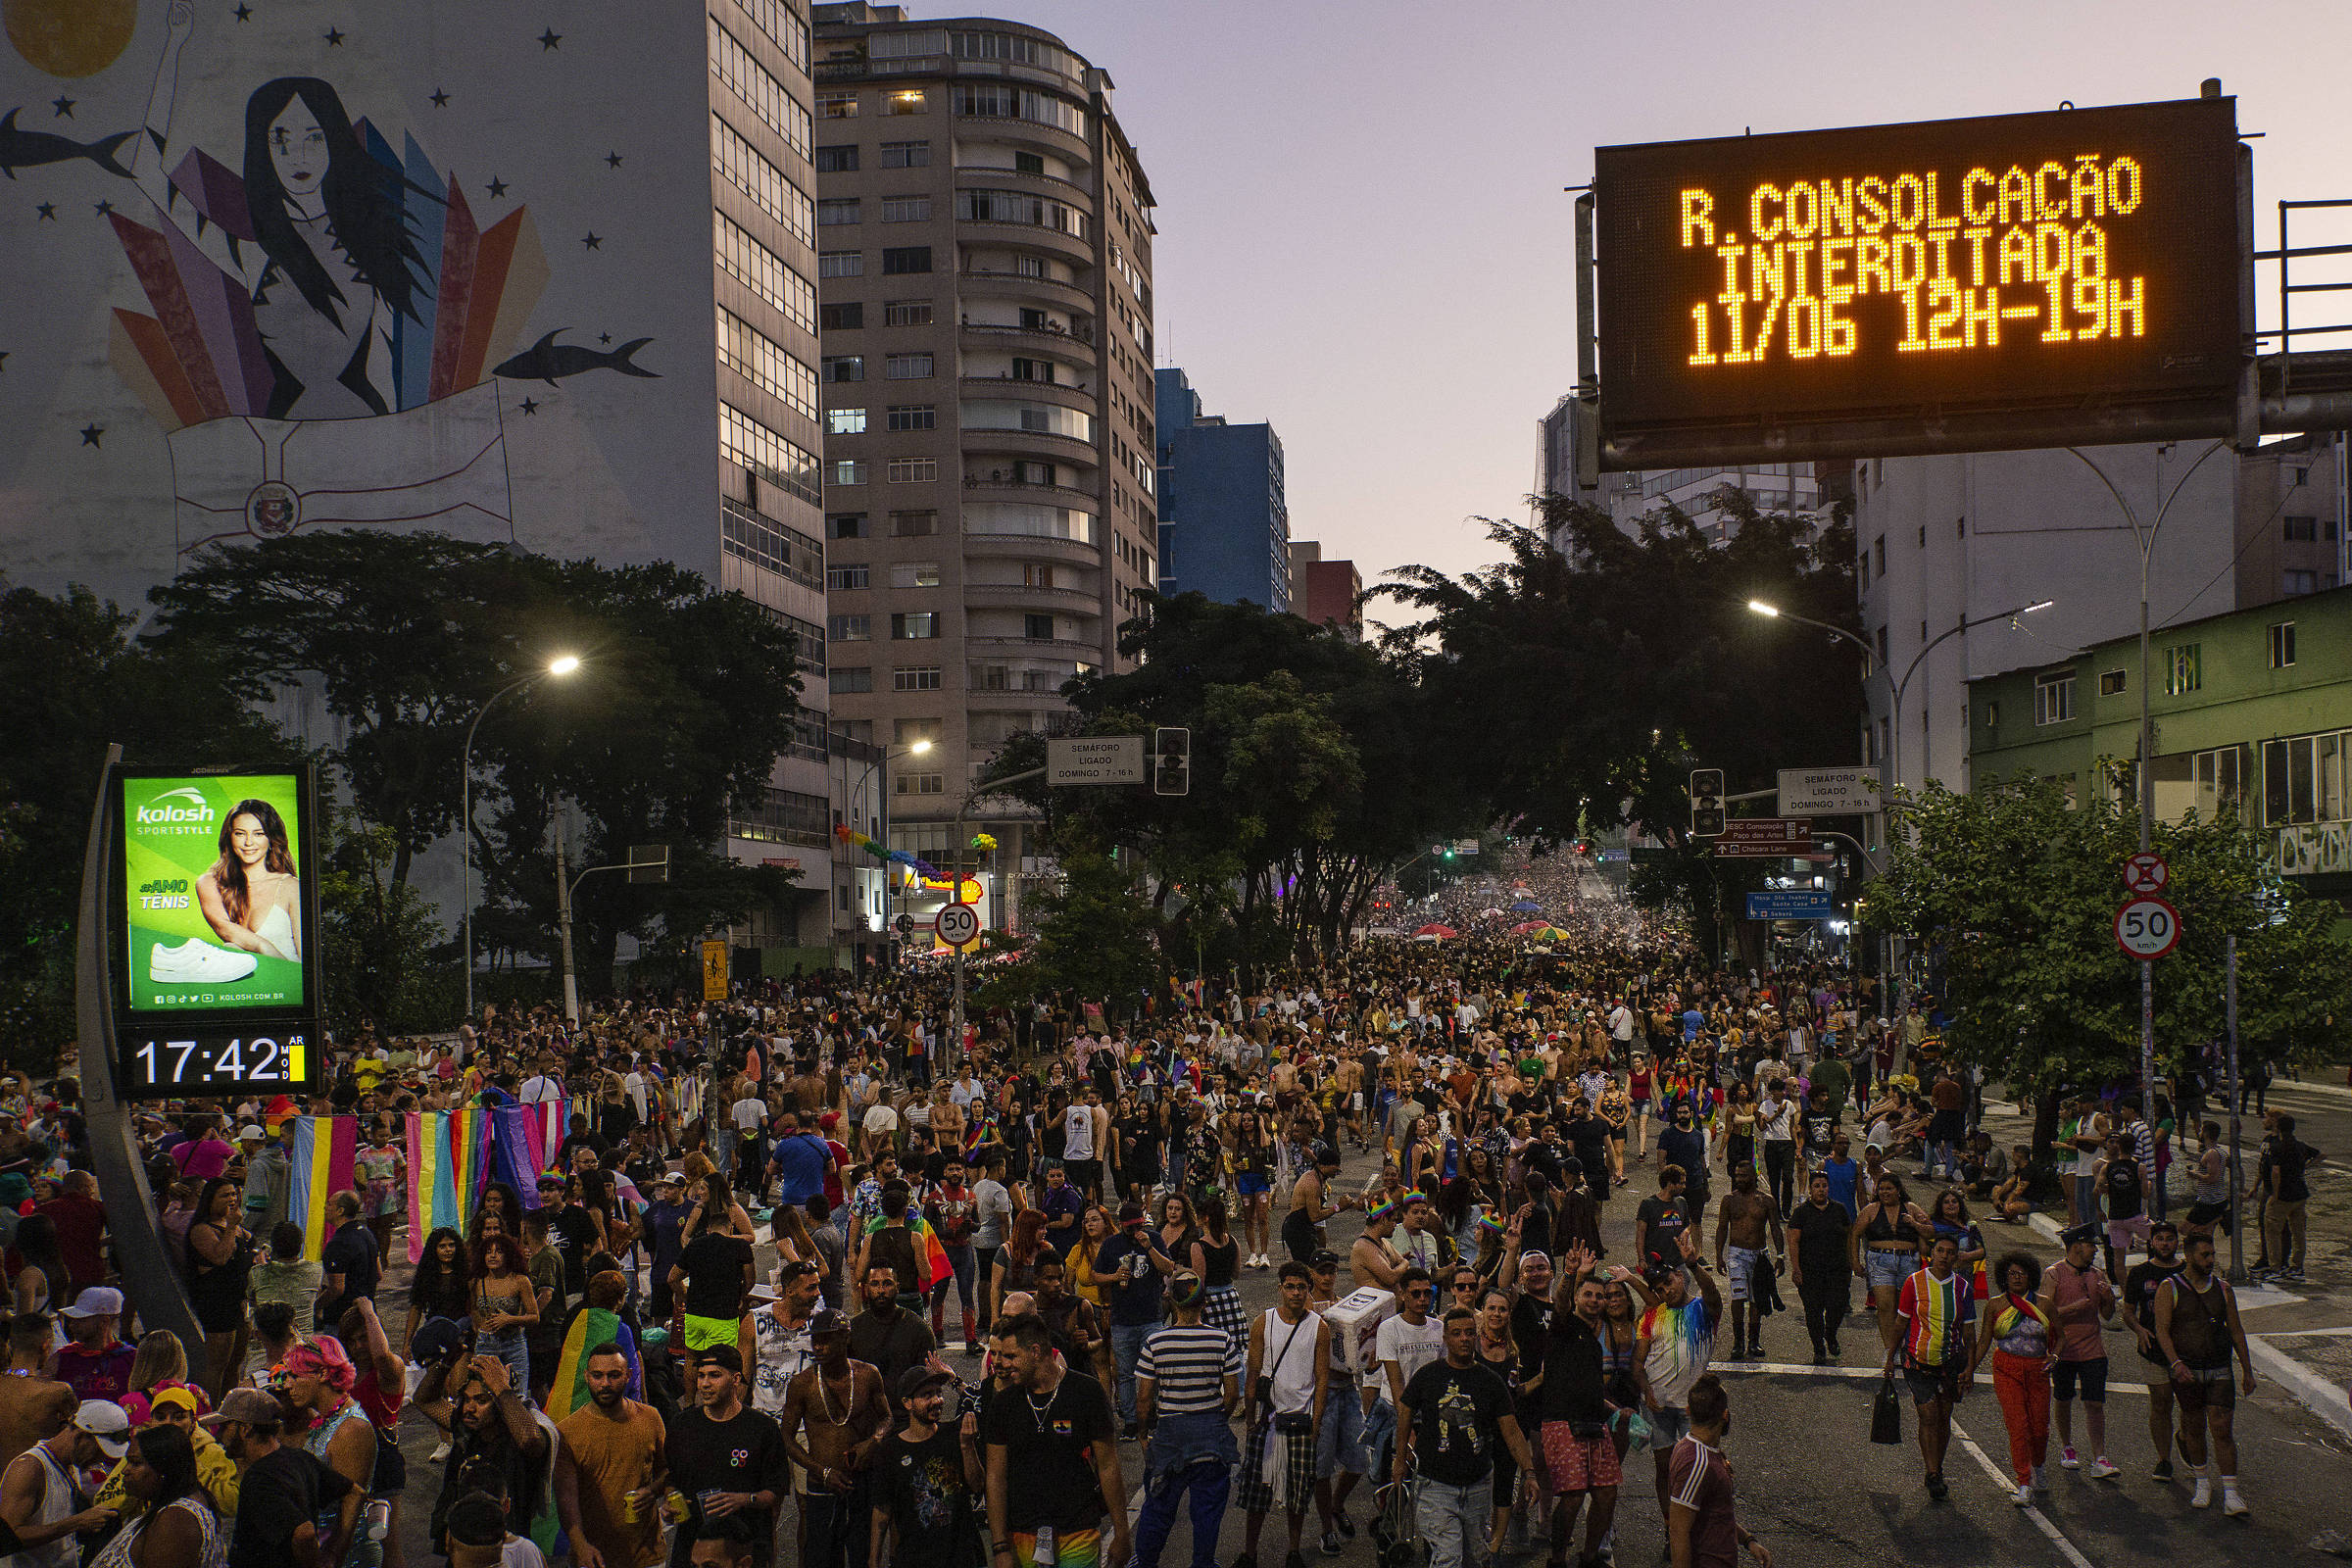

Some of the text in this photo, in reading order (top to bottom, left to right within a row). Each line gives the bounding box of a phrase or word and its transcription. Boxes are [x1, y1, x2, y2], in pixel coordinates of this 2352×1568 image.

[1681, 188, 1736, 246] R.
[1717, 220, 2107, 304] INTERDITADA
[1689, 275, 2144, 366] 11/06 12H-19H
[1071, 743, 1120, 753] SEMÁFORO
[1804, 774, 1856, 784] SEMÁFORO
[1812, 787, 1847, 796] LIGADO
[1790, 801, 1834, 809] DOMINGO
[136, 805, 215, 823] kolosh
[136, 826, 213, 836] SPORTSTYLE
[1746, 822, 1785, 831] Consolação
[139, 879, 187, 893] #AMO
[139, 893, 190, 909] TÊNIS
[944, 911, 971, 930] 50
[2126, 911, 2168, 938] 50
[220, 993, 284, 1002] KOLOSH.COM.BR
[289, 1036, 304, 1045] AR
[136, 1038, 279, 1084] 17:42
